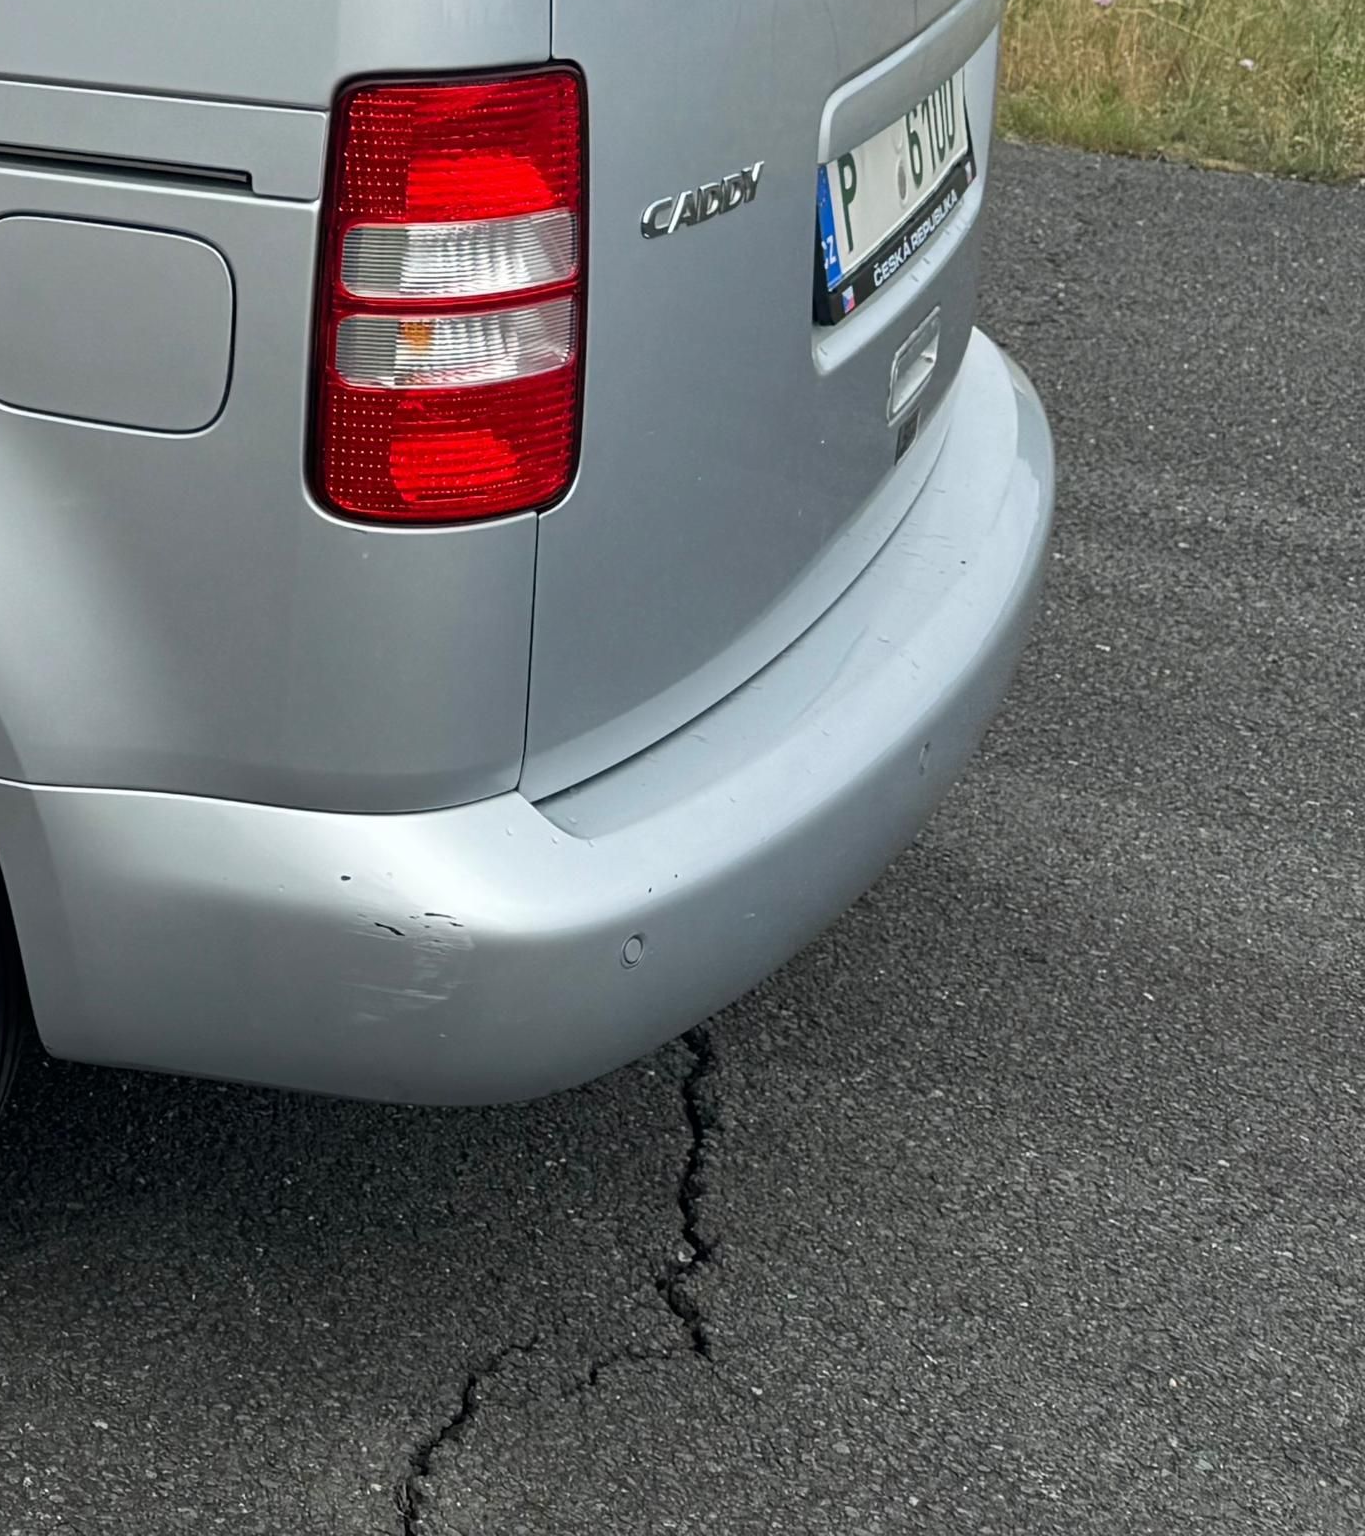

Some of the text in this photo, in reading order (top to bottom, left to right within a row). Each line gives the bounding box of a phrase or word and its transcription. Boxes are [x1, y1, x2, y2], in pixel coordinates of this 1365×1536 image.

[640, 161, 765, 240] CADDY
[837, 152, 858, 254] P
[873, 189, 958, 287] ČESKÁ REPUBLIKA
